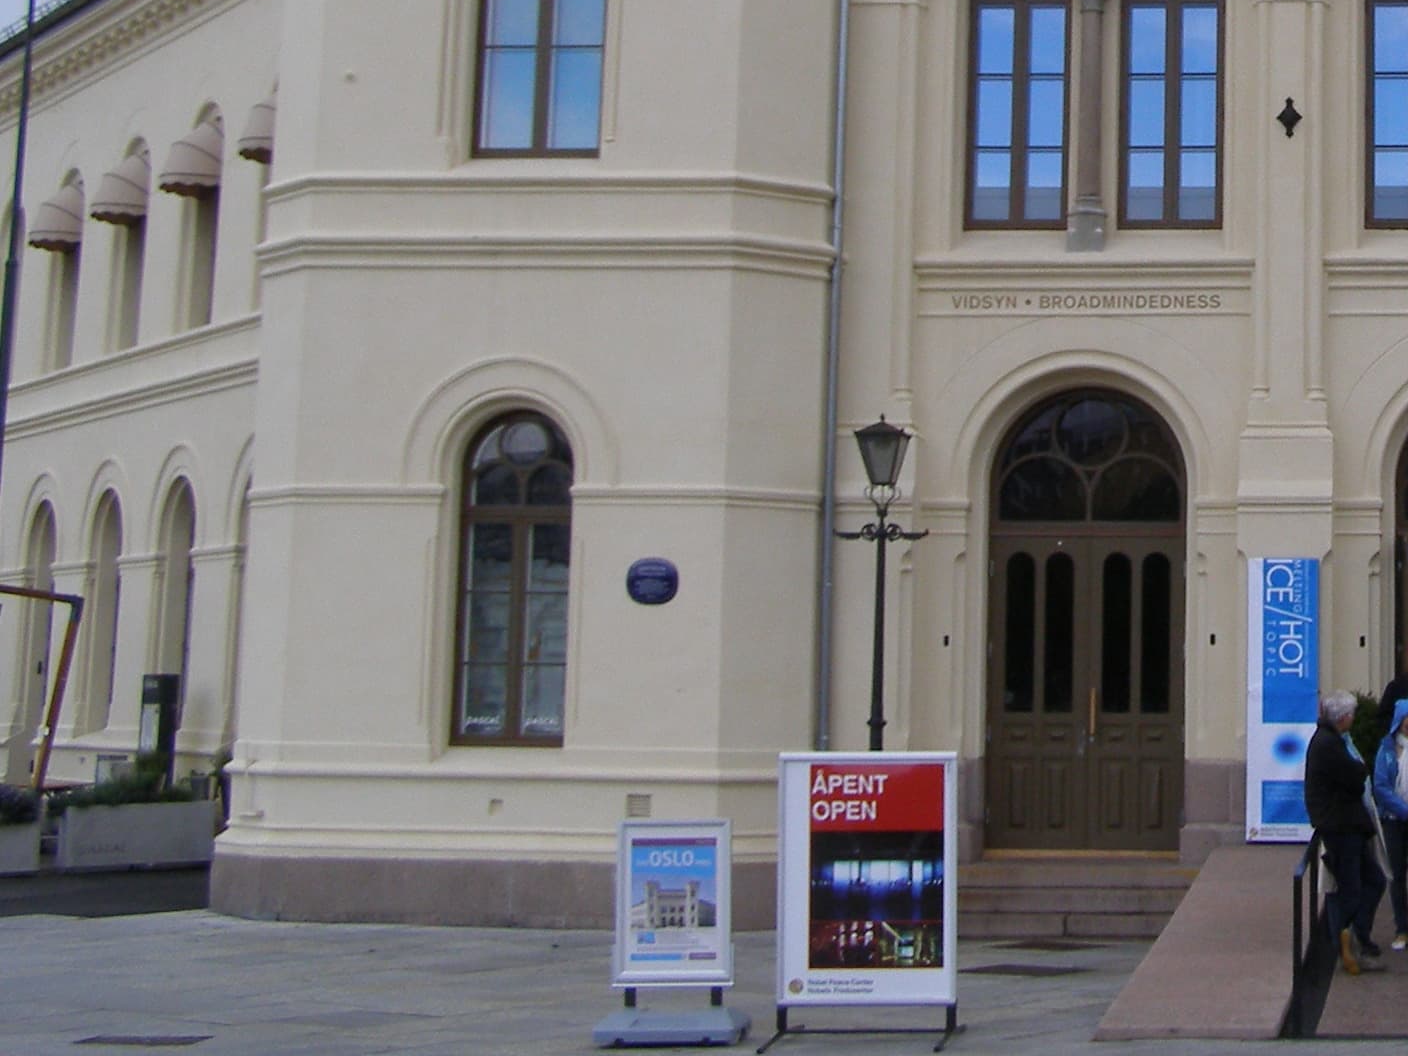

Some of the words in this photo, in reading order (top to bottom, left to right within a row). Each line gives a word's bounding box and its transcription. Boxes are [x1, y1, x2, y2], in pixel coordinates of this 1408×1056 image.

[951, 295, 1018, 310] VIDSYN
[1039, 294, 1222, 309] BROADMINDEDNESS
[1266, 620, 1277, 677] TOPIC
[812, 769, 889, 795] ÅPENT
[812, 800, 878, 821] OPEN
[649, 849, 695, 867] OSLO
